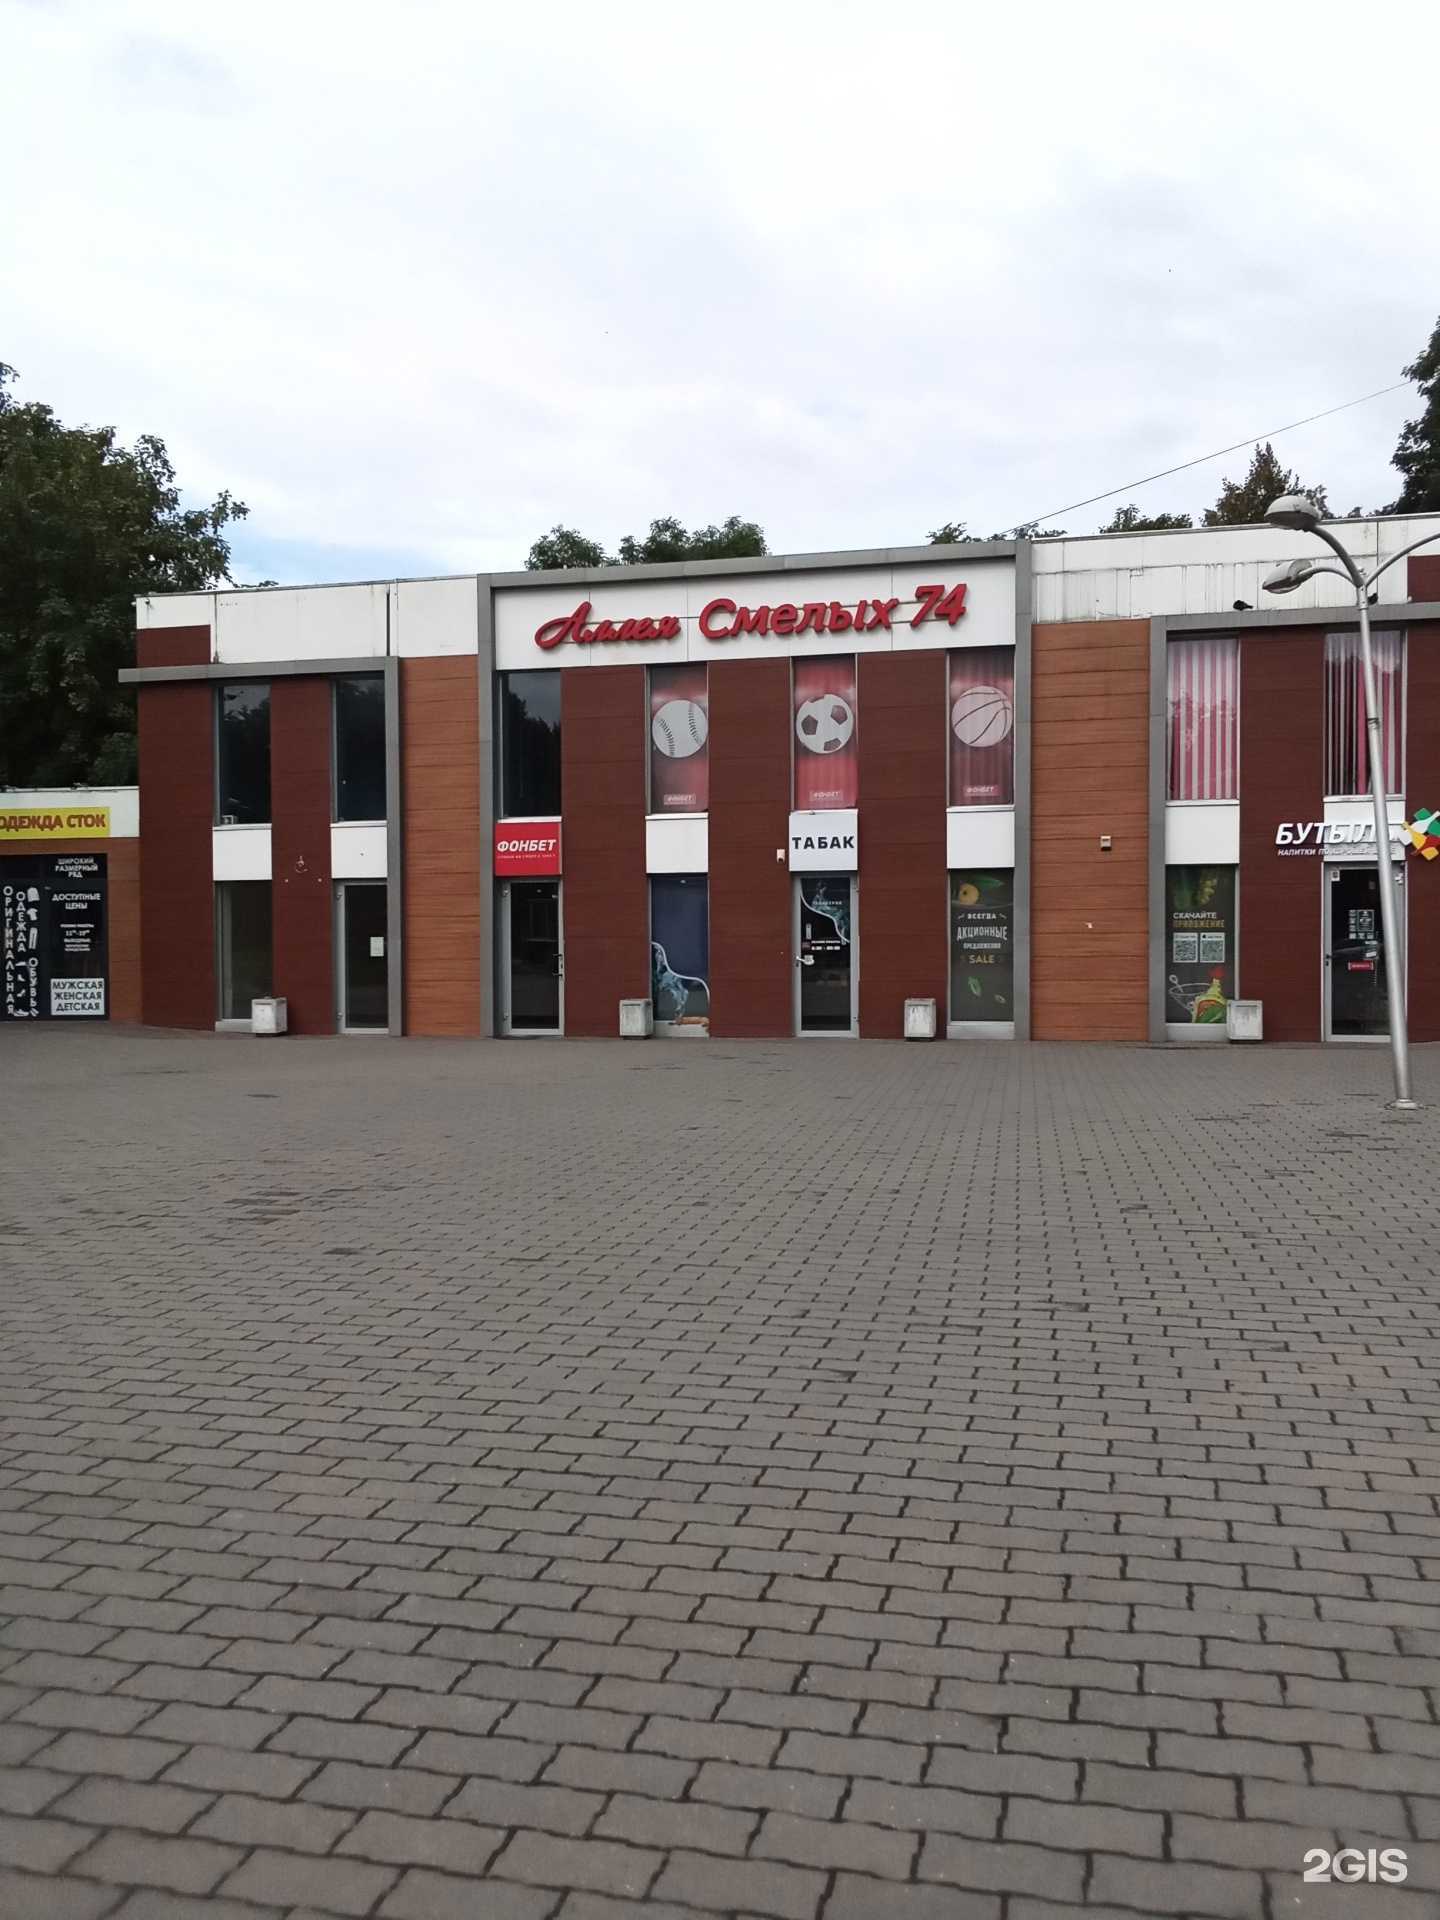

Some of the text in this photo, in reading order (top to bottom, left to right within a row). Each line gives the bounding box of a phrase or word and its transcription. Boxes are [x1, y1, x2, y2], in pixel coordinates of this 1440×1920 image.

[534, 583, 968, 650] Аллея Смелых 74
[66, 814, 106, 828] СТОК
[1275, 822, 1395, 845] БУТЫЛ
[497, 839, 557, 852] ФОНБЕТ
[791, 835, 855, 850] ТАБАК
[1278, 848, 1316, 856] НАПИТКИ
[52, 893, 101, 902] ДОСТУПНЫЕ
[65, 902, 88, 910] ЦЕНЫ
[1173, 911, 1217, 919] СКАЧАЙТЕ
[957, 926, 1008, 941] АКЦИОННЫЕ
[968, 954, 995, 964] SALE
[52, 981, 103, 990] МУЖСКАЯ
[55, 991, 102, 1000] ЖЕНСКАЯ
[56, 1002, 100, 1012] ДЕТСКАЯ
